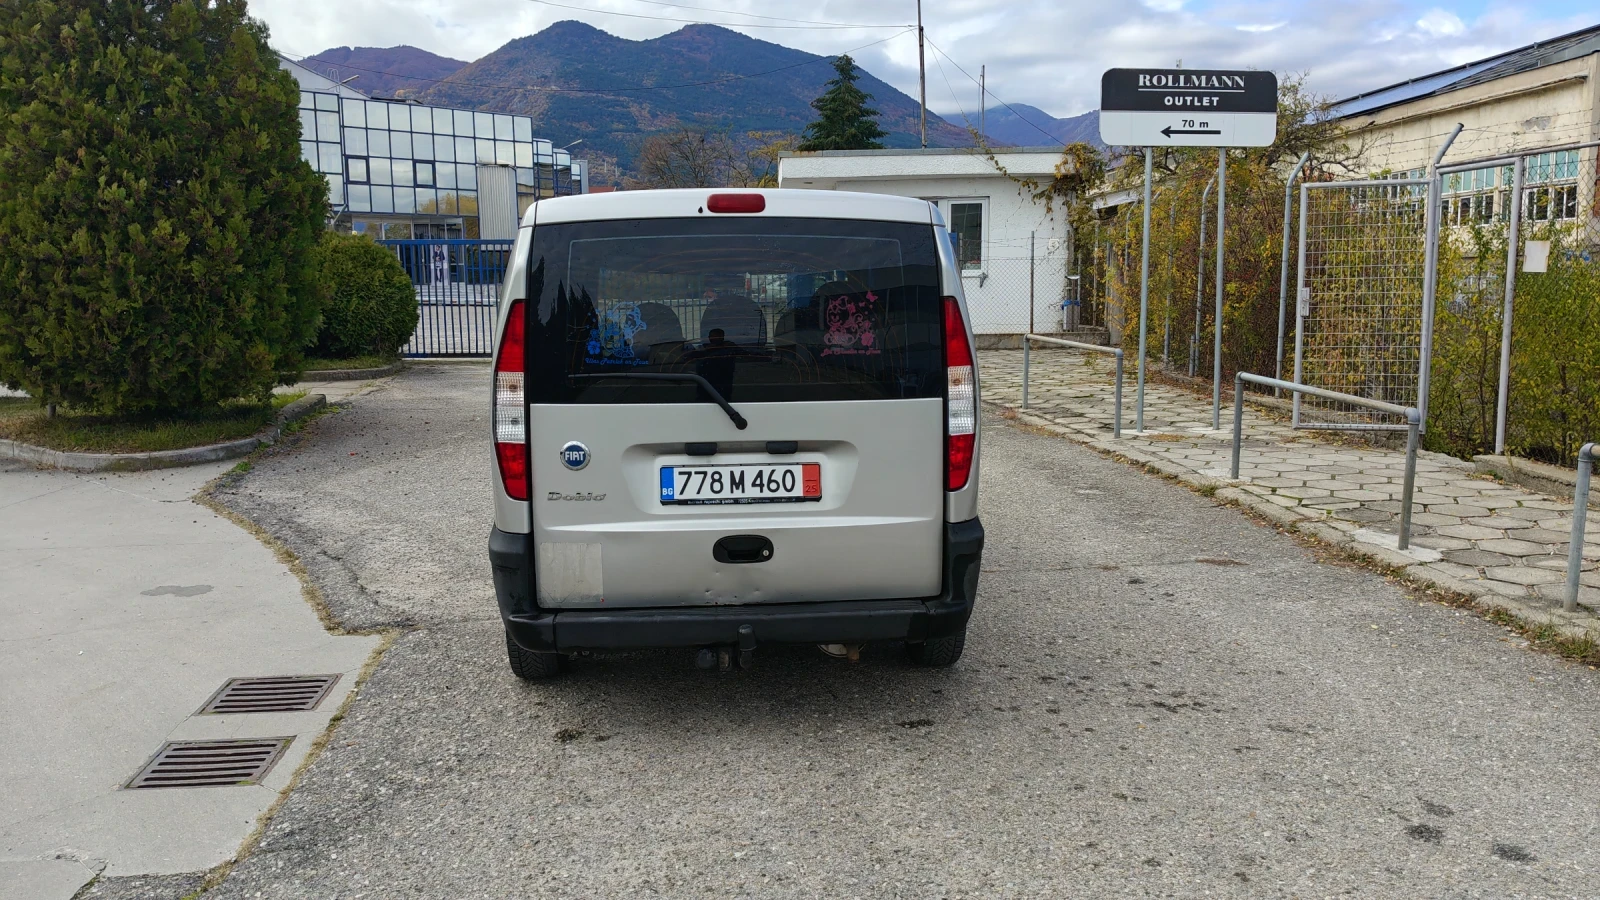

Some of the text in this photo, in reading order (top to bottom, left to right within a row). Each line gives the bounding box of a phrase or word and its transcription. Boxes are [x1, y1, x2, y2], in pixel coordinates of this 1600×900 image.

[1138, 74, 1245, 88] ROLLMANN
[1164, 96, 1220, 106] OUTLET
[1181, 119, 1195, 128] 70
[565, 451, 584, 461] FIAT
[662, 488, 674, 496] BG
[678, 470, 724, 495] 778
[729, 469, 746, 494] M
[751, 468, 796, 493] 460
